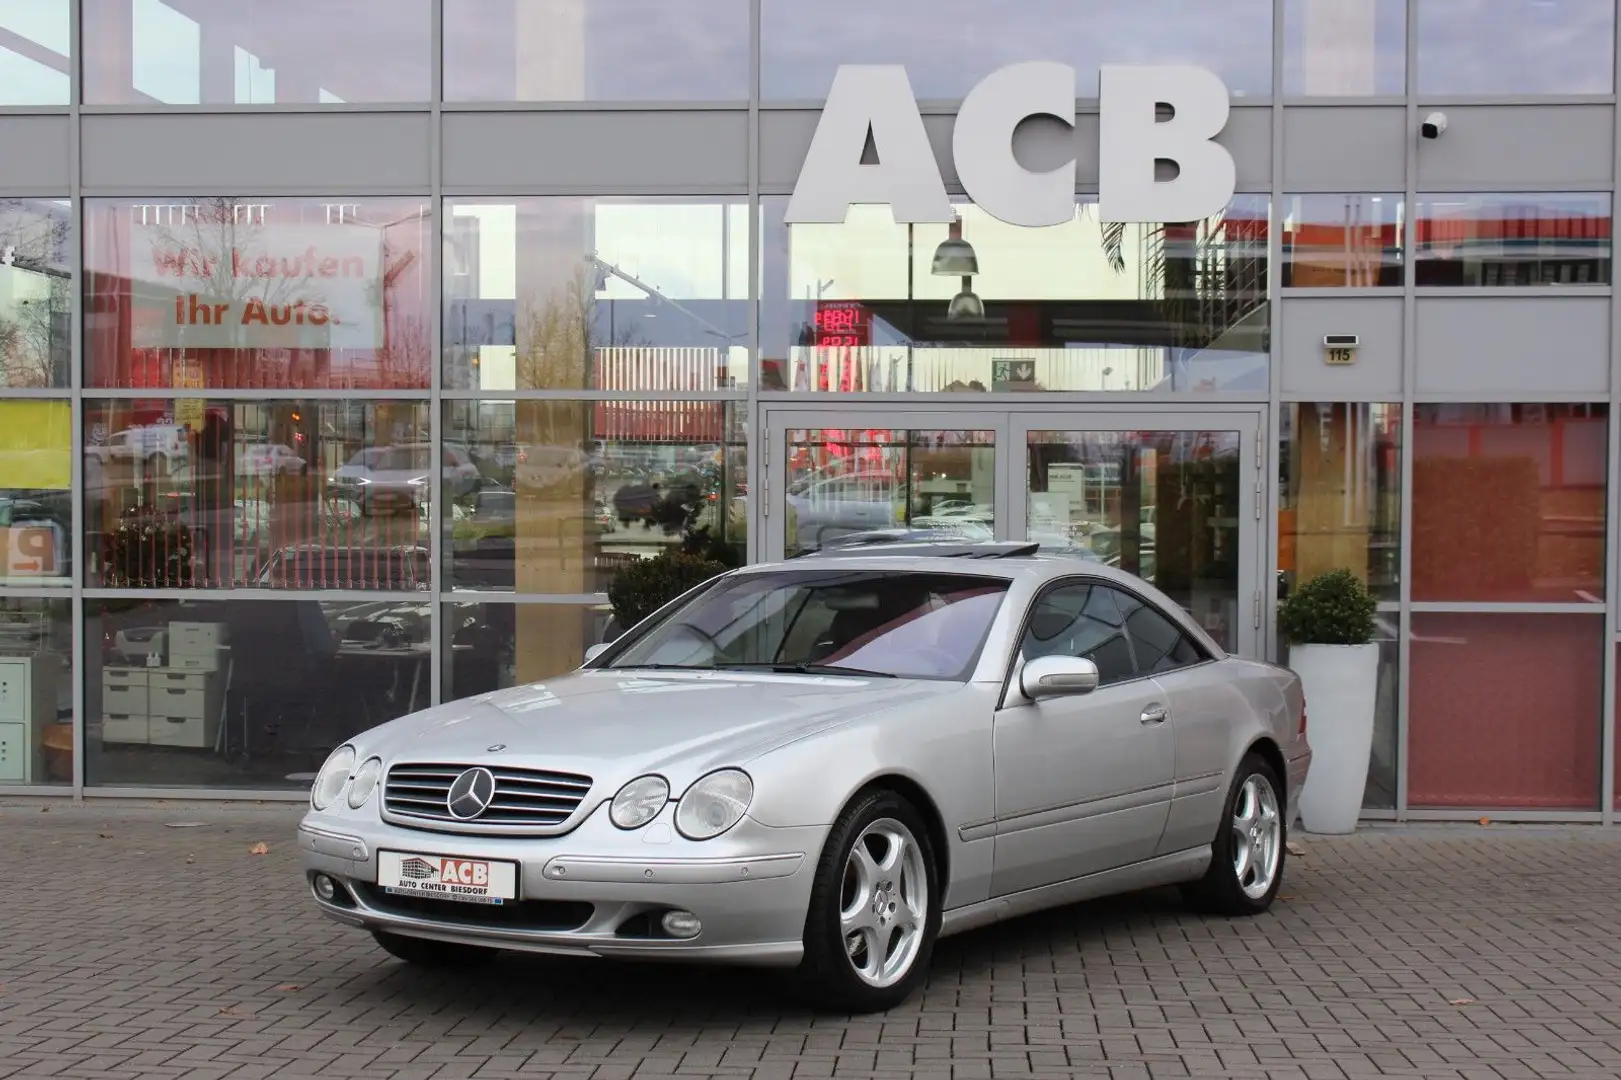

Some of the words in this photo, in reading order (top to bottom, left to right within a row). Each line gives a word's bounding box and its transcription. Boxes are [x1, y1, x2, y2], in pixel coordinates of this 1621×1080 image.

[783, 60, 1236, 228] ACB
[231, 245, 364, 278] kaufen
[175, 294, 230, 325] Ihr
[240, 296, 341, 326] Auto.
[1329, 348, 1350, 362] 115
[442, 861, 488, 885] ACB
[399, 879, 417, 889] AUTO
[420, 882, 447, 892] CENTER
[450, 885, 488, 896] BIESDORF
